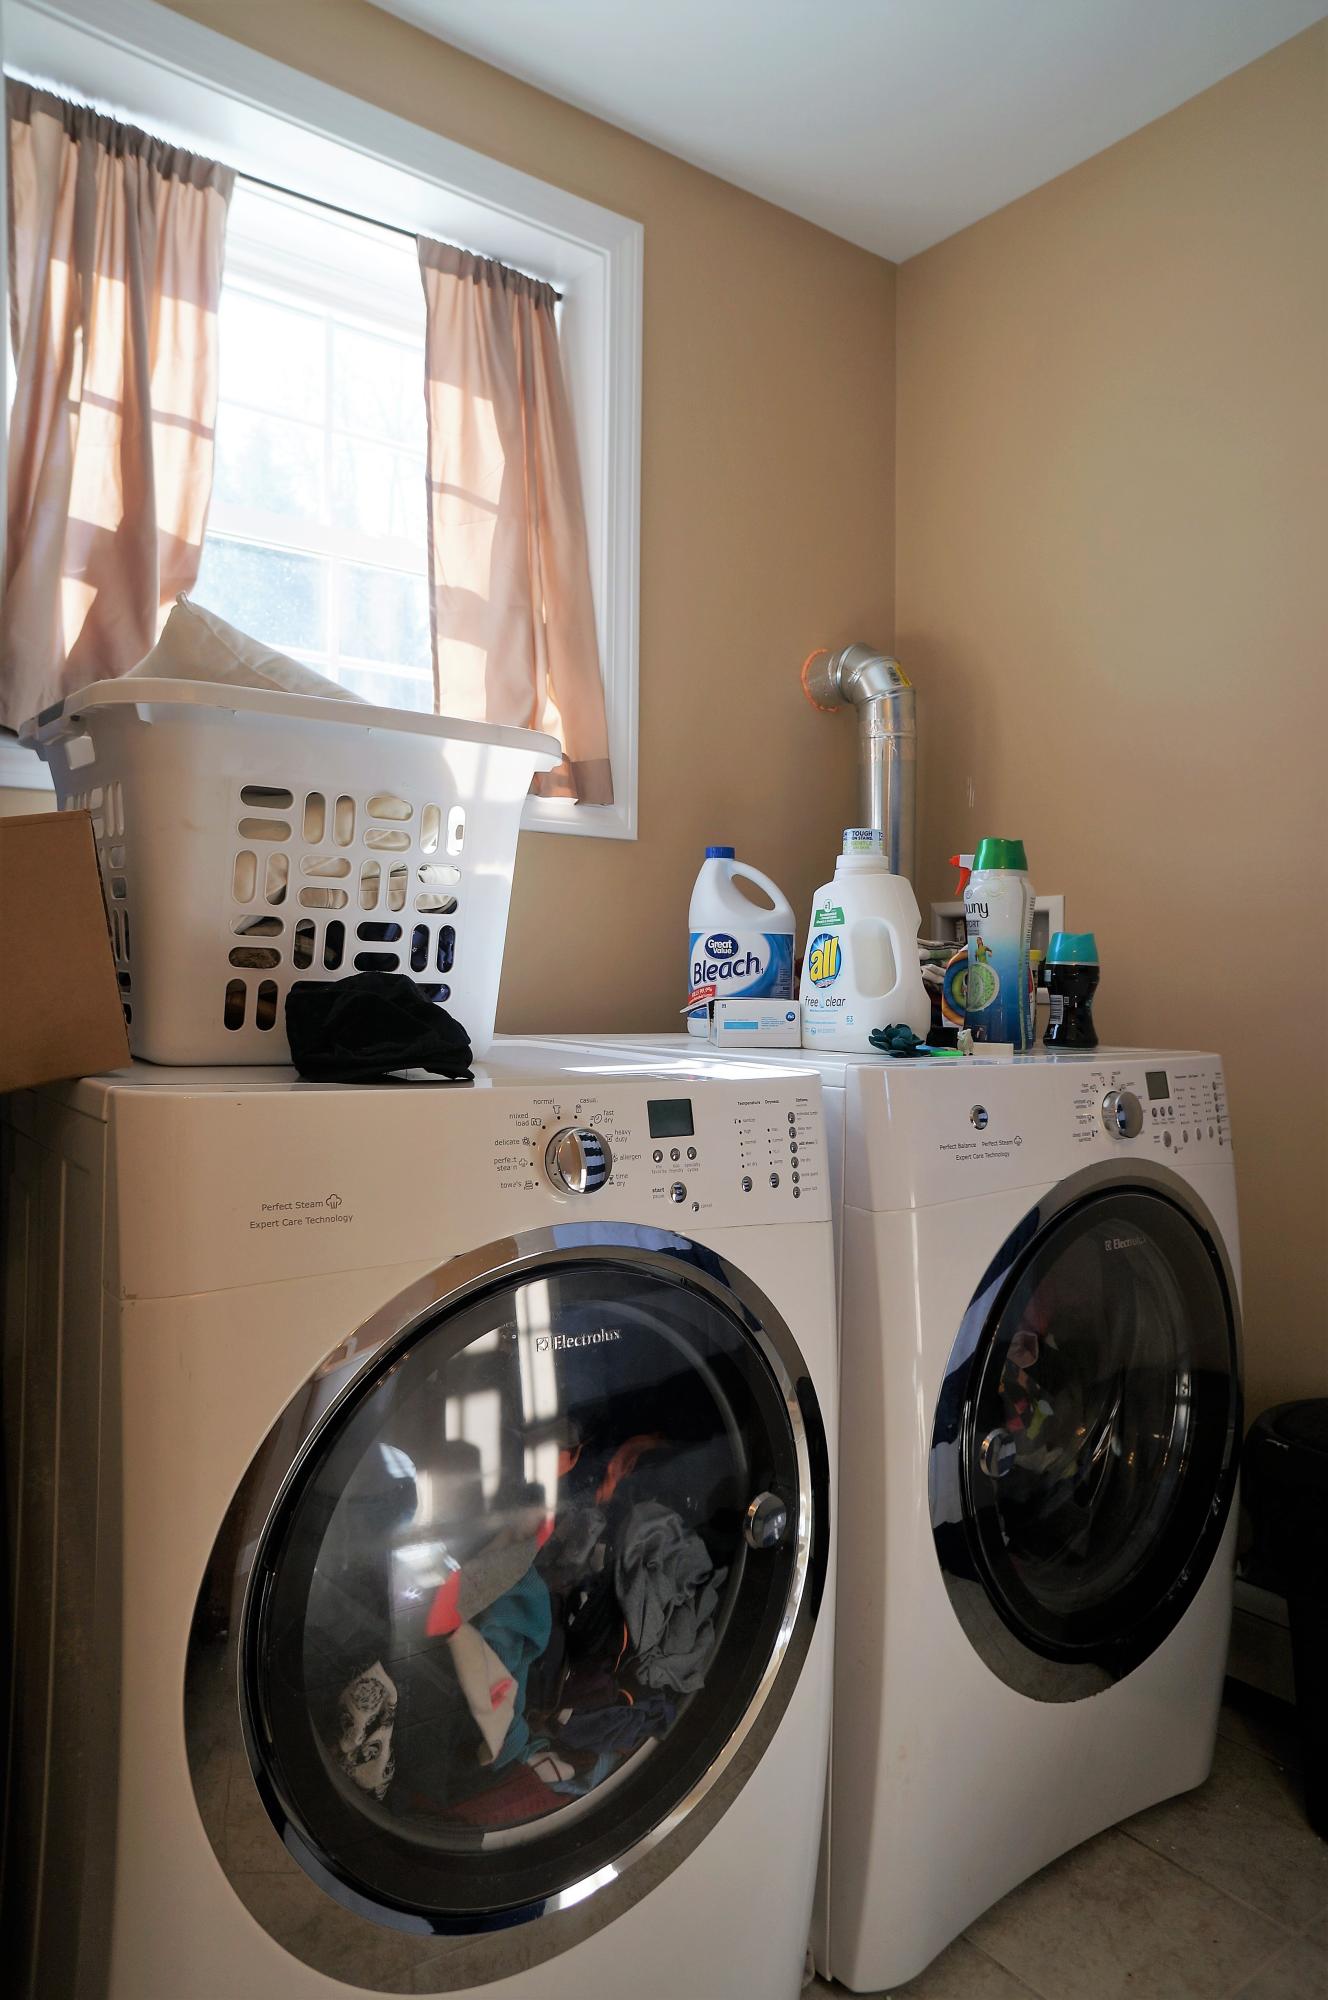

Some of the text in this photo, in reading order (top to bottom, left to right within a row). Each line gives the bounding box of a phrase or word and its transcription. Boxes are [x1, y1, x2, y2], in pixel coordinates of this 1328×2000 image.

[964, 903, 988, 918] wny
[707, 939, 733, 949] Great
[713, 946, 732, 954] Value
[810, 936, 839, 983] all
[694, 952, 760, 985] Bleach
[805, 995, 846, 1007] free clear
[515, 1119, 530, 1127] load
[494, 1138, 520, 1146] delicate
[261, 1200, 324, 1211] Perfect Steam
[250, 1213, 354, 1230] Expert Care Technology
[554, 1328, 622, 1351] Electrolux
